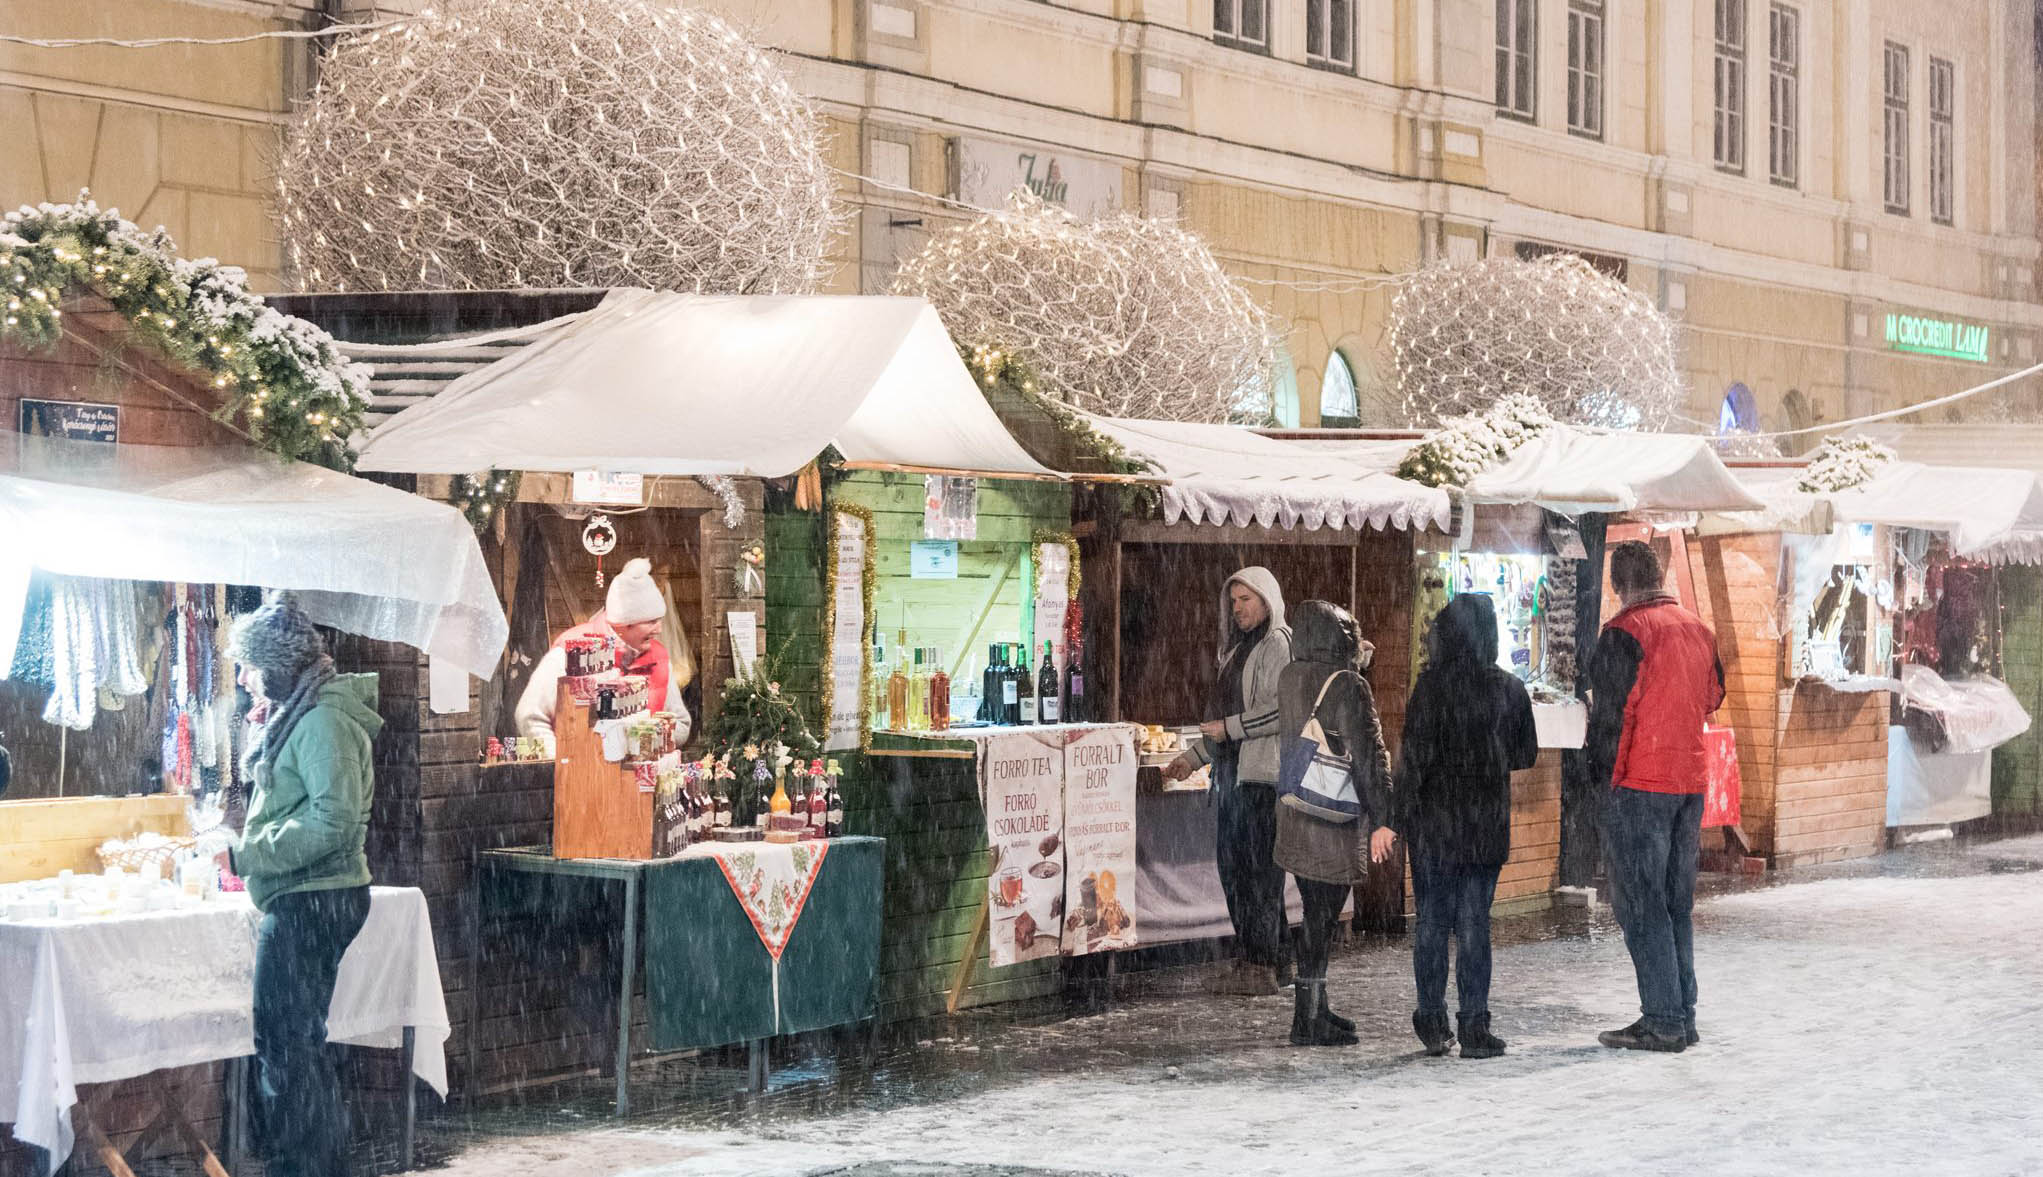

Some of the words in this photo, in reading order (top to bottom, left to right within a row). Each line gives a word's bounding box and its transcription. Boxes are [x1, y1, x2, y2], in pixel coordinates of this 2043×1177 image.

[1886, 313, 1953, 349] MCROCREDIT
[993, 753, 1029, 779] FORRÓ
[1032, 757, 1052, 776] TEA
[1073, 743, 1125, 768] FORRALT
[1086, 767, 1108, 789] BOR
[1005, 787, 1037, 812] FORRÓ
[994, 809, 1049, 837] CSOKOLÁDÉ
